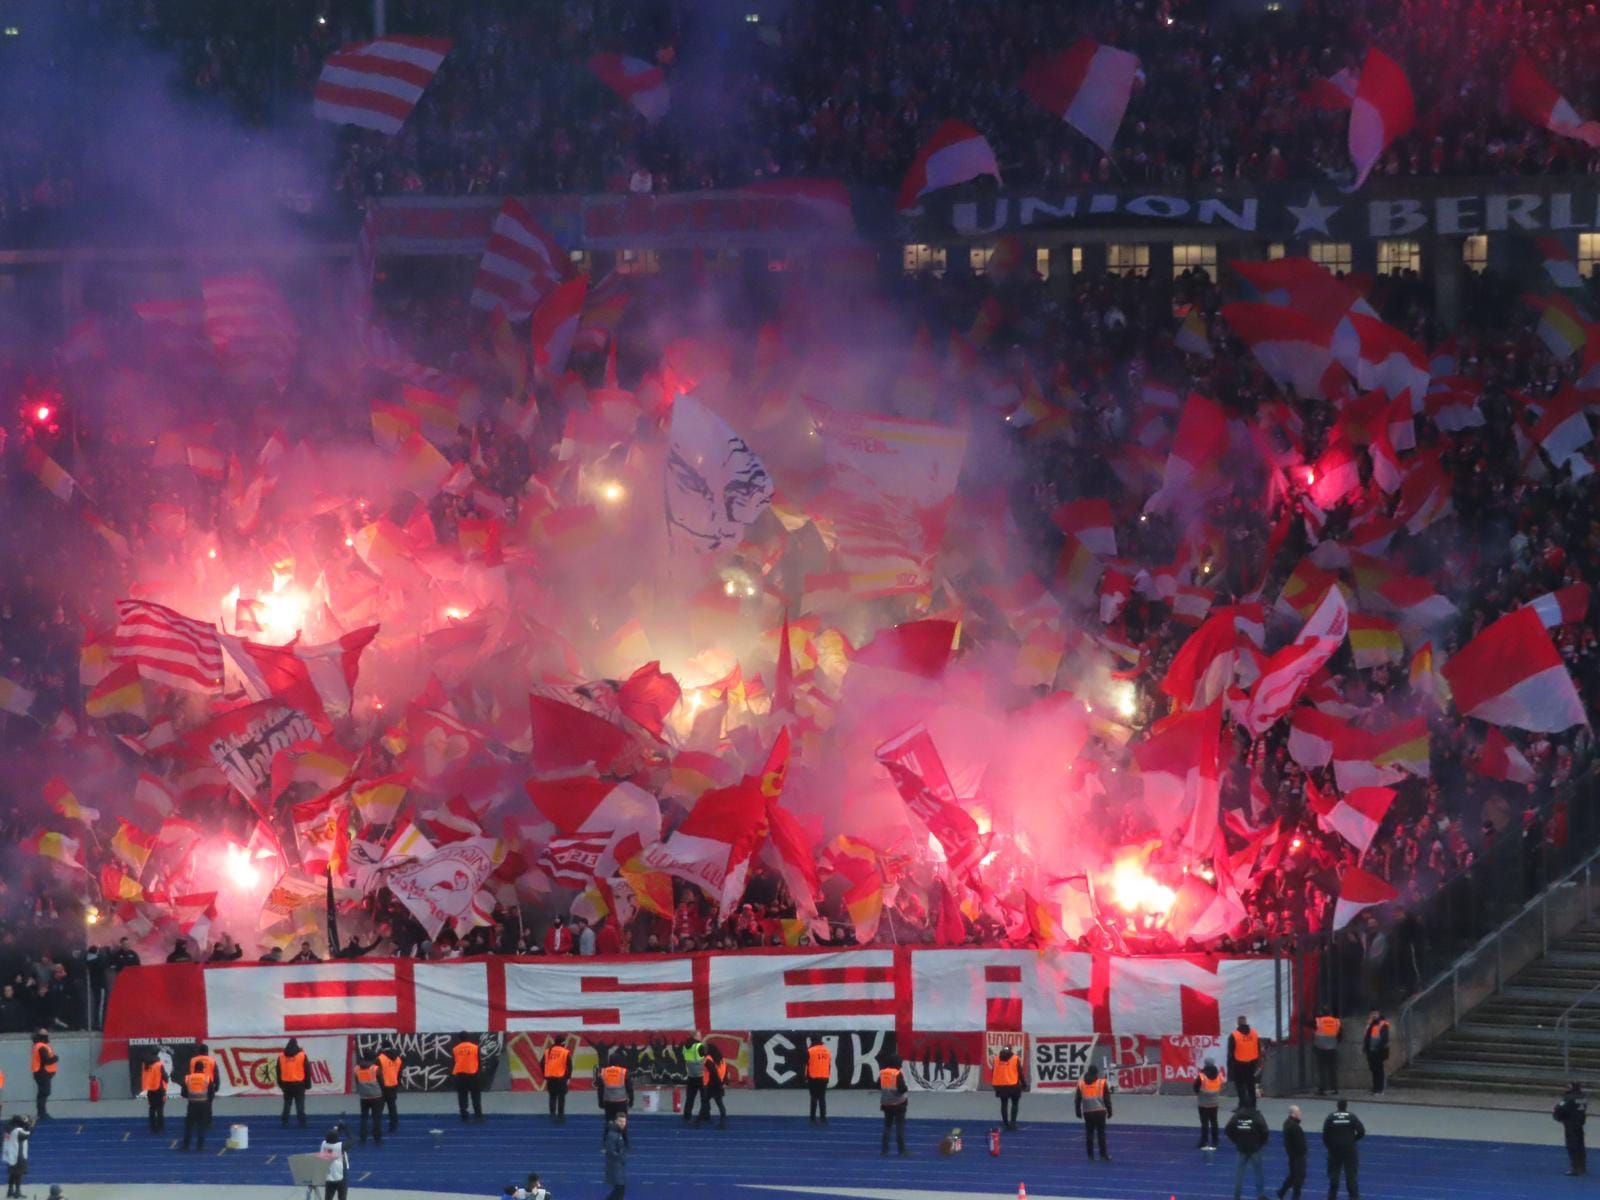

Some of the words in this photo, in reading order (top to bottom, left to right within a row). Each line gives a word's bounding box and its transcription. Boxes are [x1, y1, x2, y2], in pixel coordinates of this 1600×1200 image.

[953, 195, 1257, 235] UNION
[1368, 193, 1600, 236] BERL
[204, 948, 1292, 1040] EISERN
[988, 1033, 1021, 1046] UNION
[1037, 1044, 1091, 1063] SEK
[1169, 1035, 1220, 1049] GARDE
[764, 1031, 886, 1088] EK
